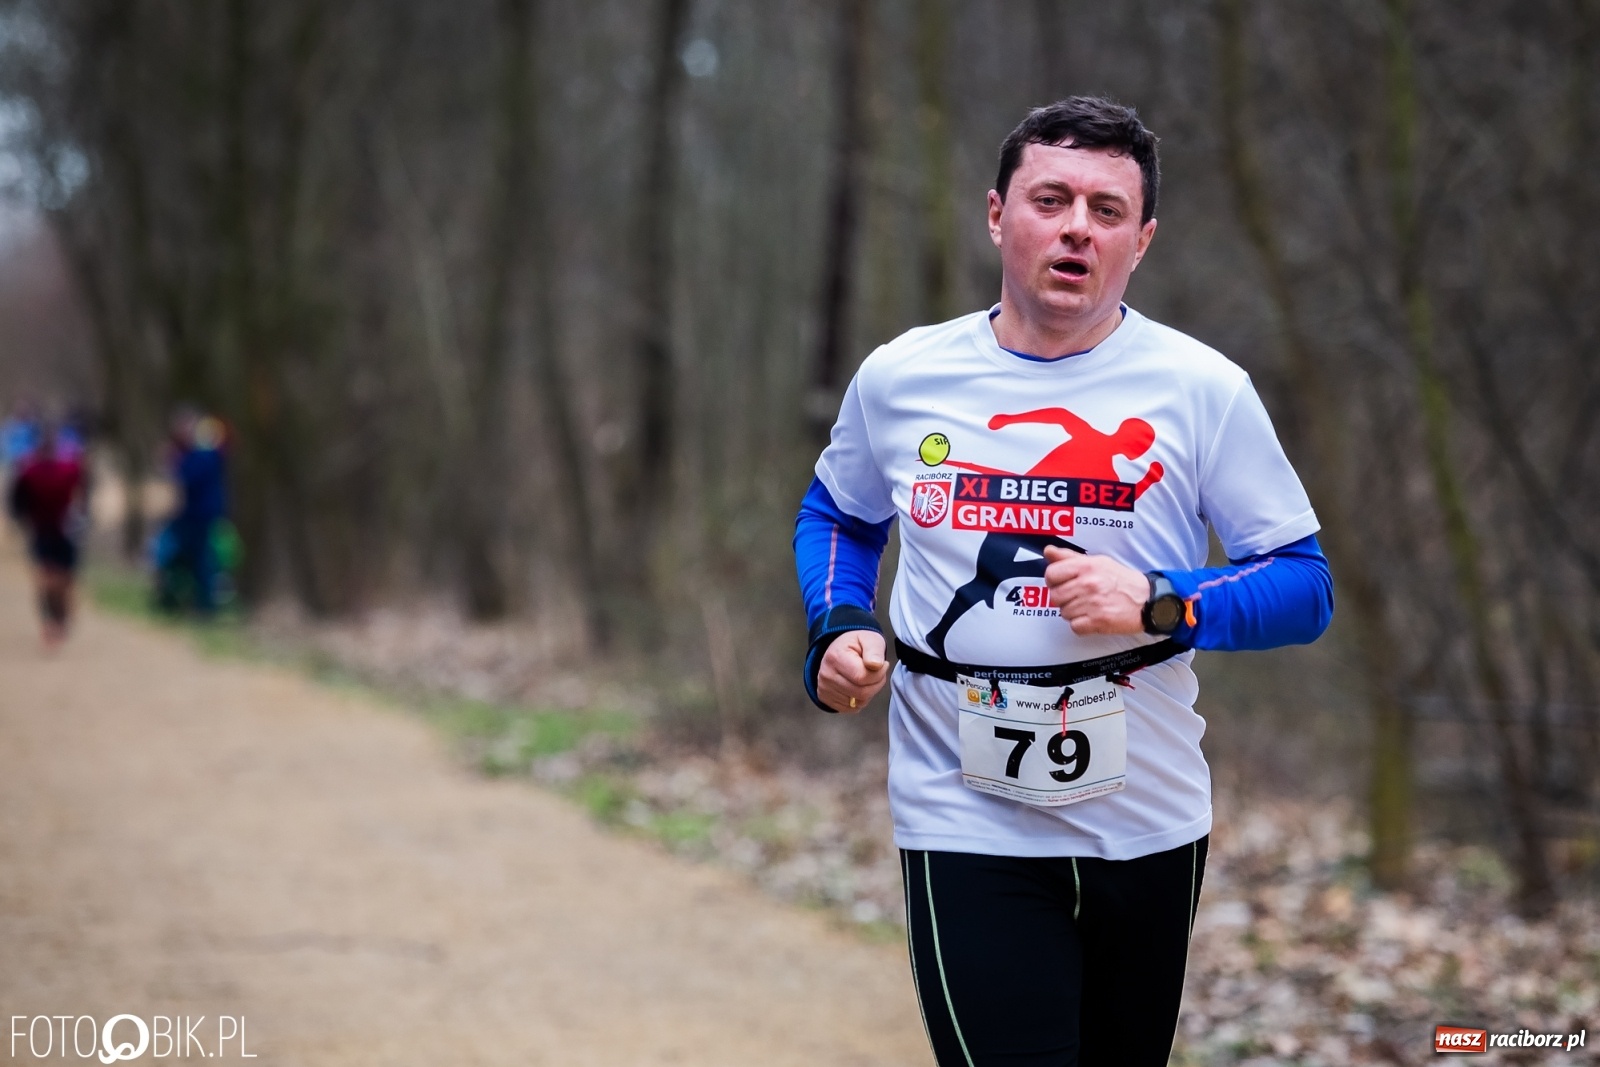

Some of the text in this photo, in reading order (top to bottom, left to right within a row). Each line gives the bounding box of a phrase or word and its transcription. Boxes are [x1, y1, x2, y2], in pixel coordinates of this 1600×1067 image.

[915, 472, 952, 480] RACIBÓRZ
[958, 476, 1132, 508] XI BIEG BEZ
[957, 506, 1072, 531] GRANIC
[1075, 516, 1134, 529] 03.05.2018
[974, 670, 1052, 679] performance
[1016, 688, 1117, 712] www.peonalbest.pl
[994, 725, 1091, 783] 79
